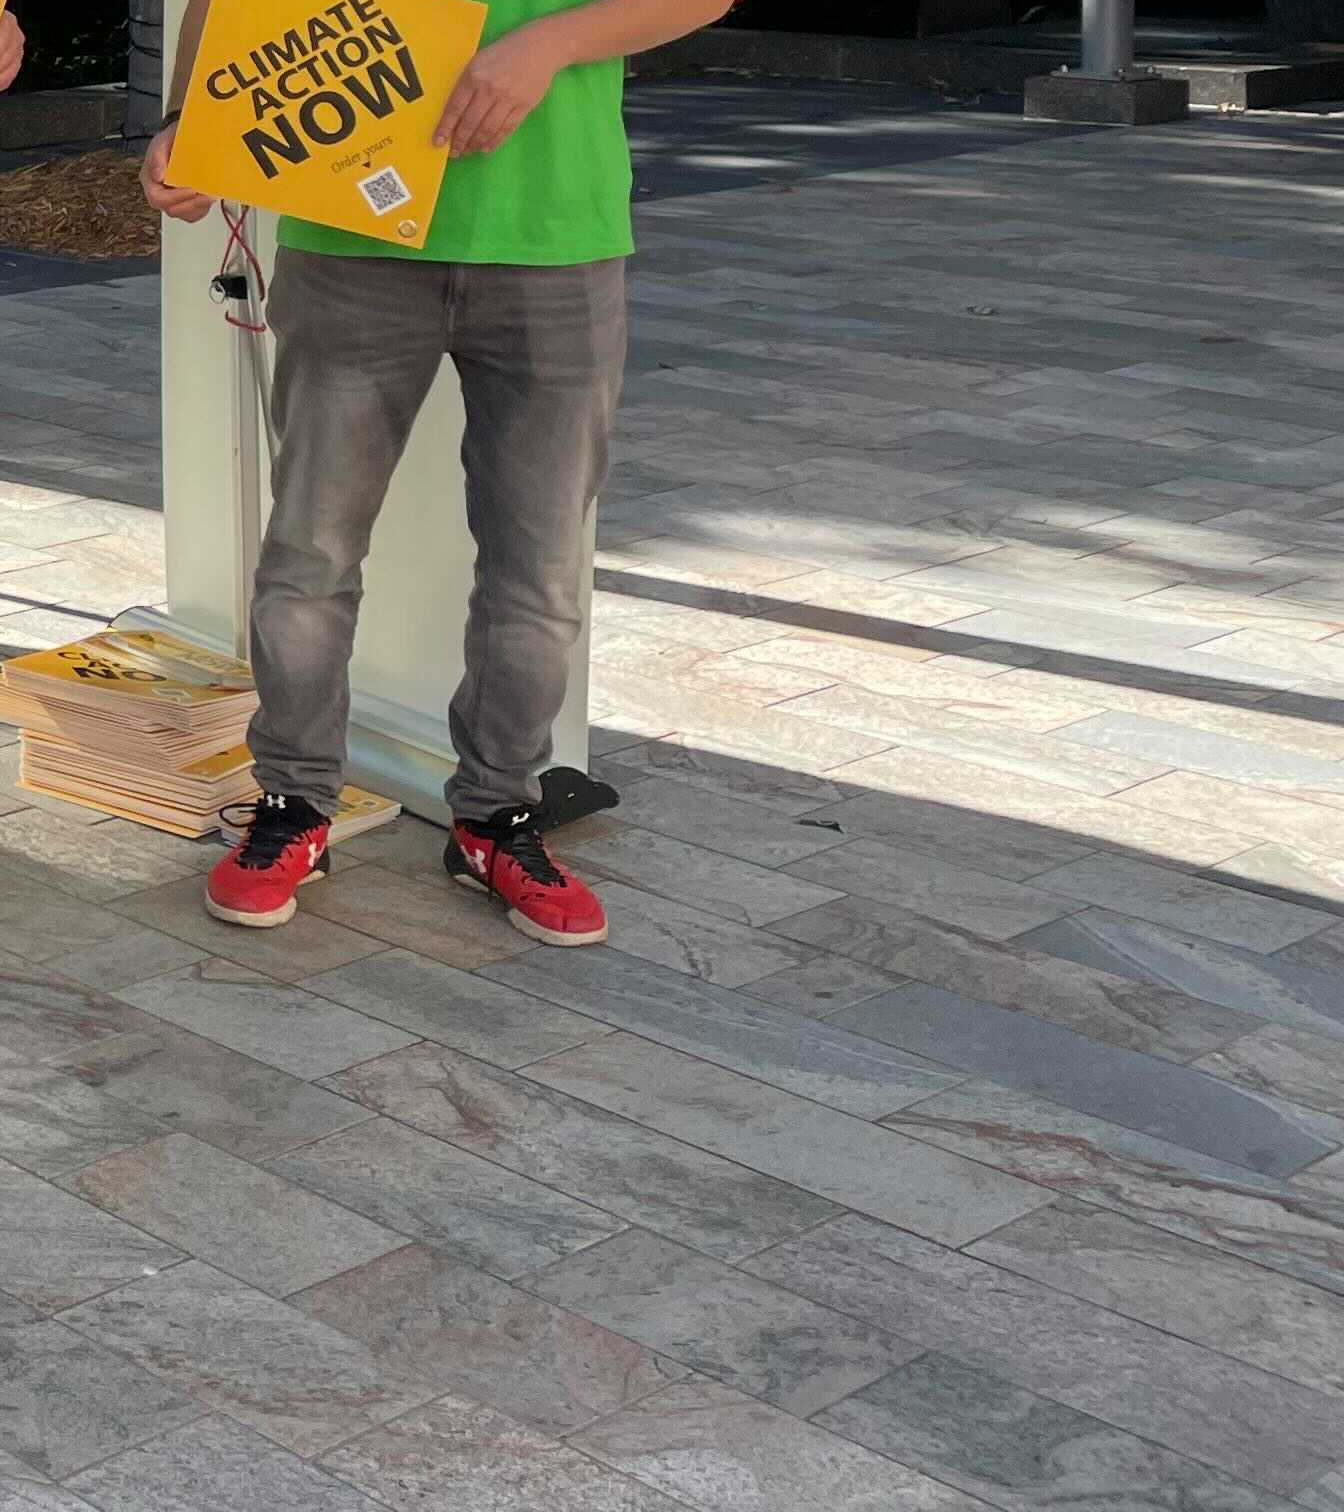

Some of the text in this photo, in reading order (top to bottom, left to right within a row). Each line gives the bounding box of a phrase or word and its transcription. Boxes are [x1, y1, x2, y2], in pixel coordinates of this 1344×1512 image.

[240, 45, 425, 181] NOW
[250, 17, 405, 124] ACTION
[331, 136, 394, 173] Order yours
